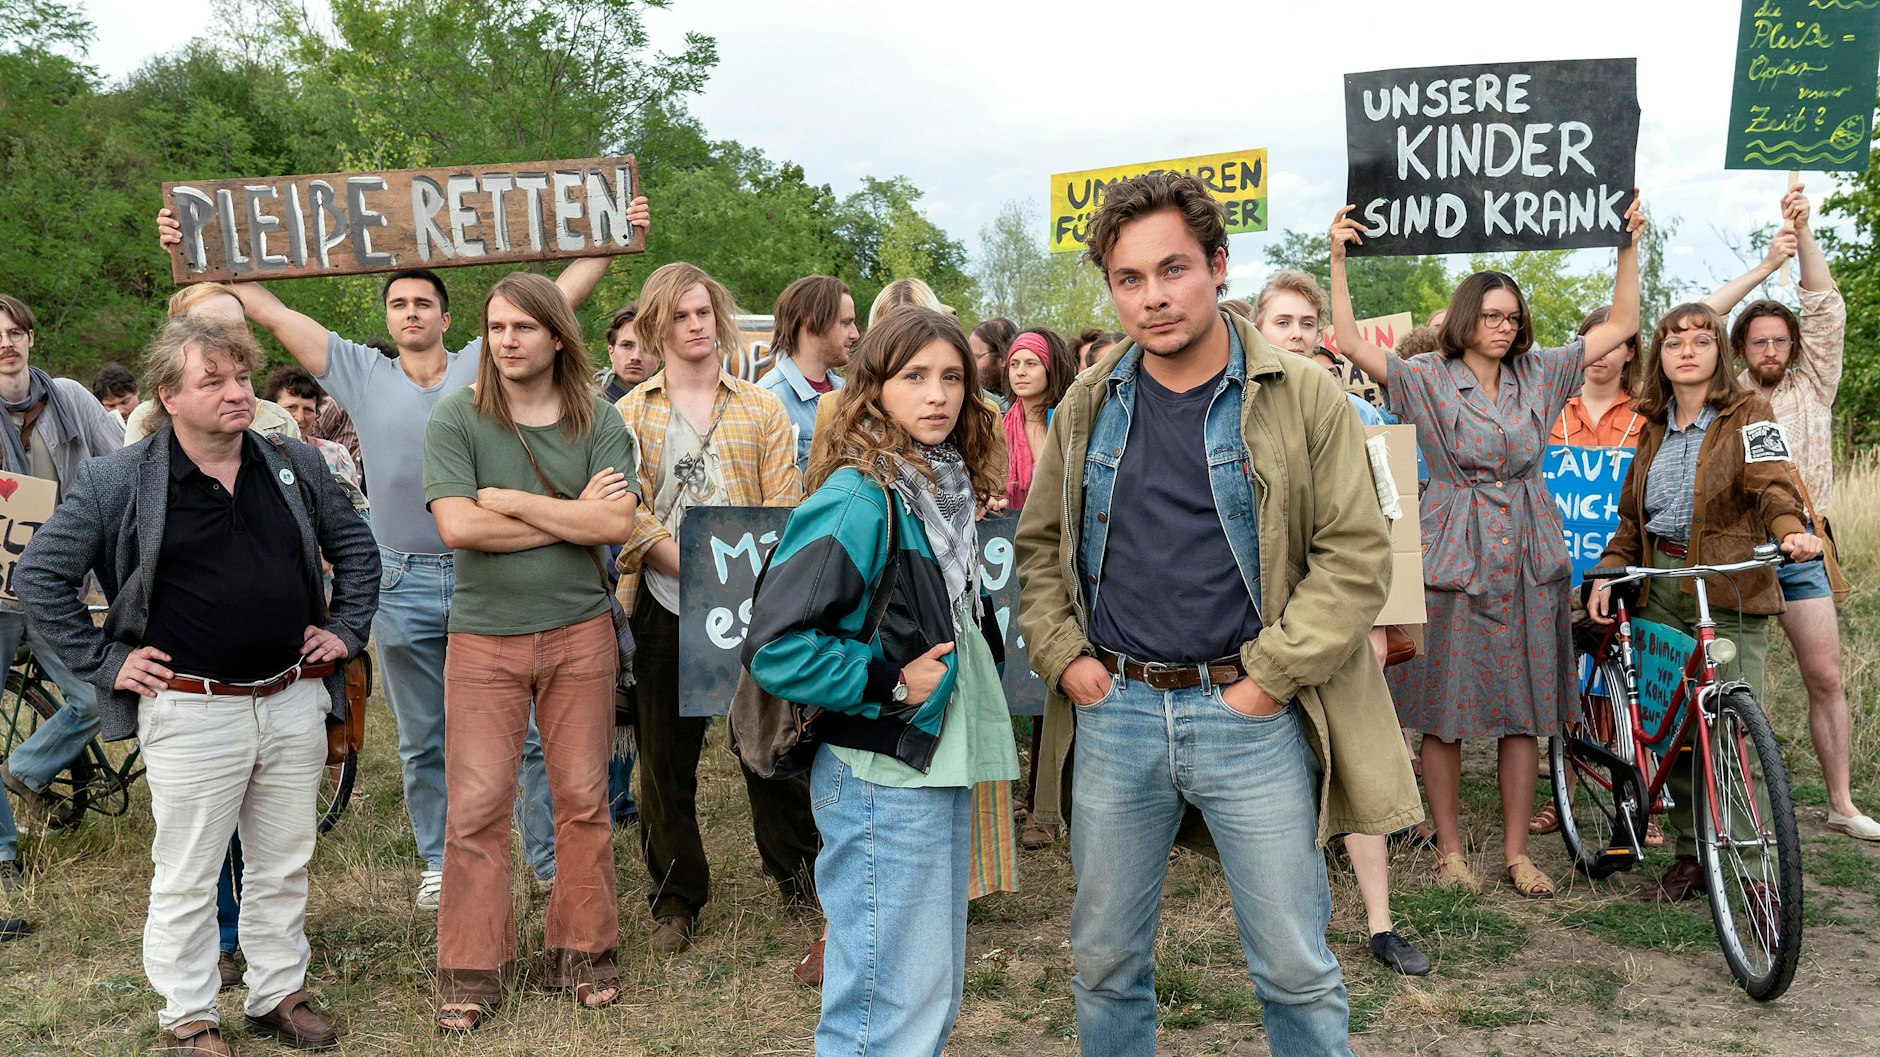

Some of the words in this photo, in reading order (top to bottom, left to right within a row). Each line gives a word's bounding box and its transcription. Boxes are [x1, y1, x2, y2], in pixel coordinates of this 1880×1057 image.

[1362, 73, 1532, 121] UNSERE
[1397, 120, 1597, 181] KINDER
[411, 162, 633, 262] RETTEN
[1056, 213, 1093, 244] FÜ
[1363, 192, 1467, 239] SIND
[1483, 183, 1625, 239] KRANK
[1323, 323, 1394, 355] KIN
[1543, 450, 1635, 482] AUT
